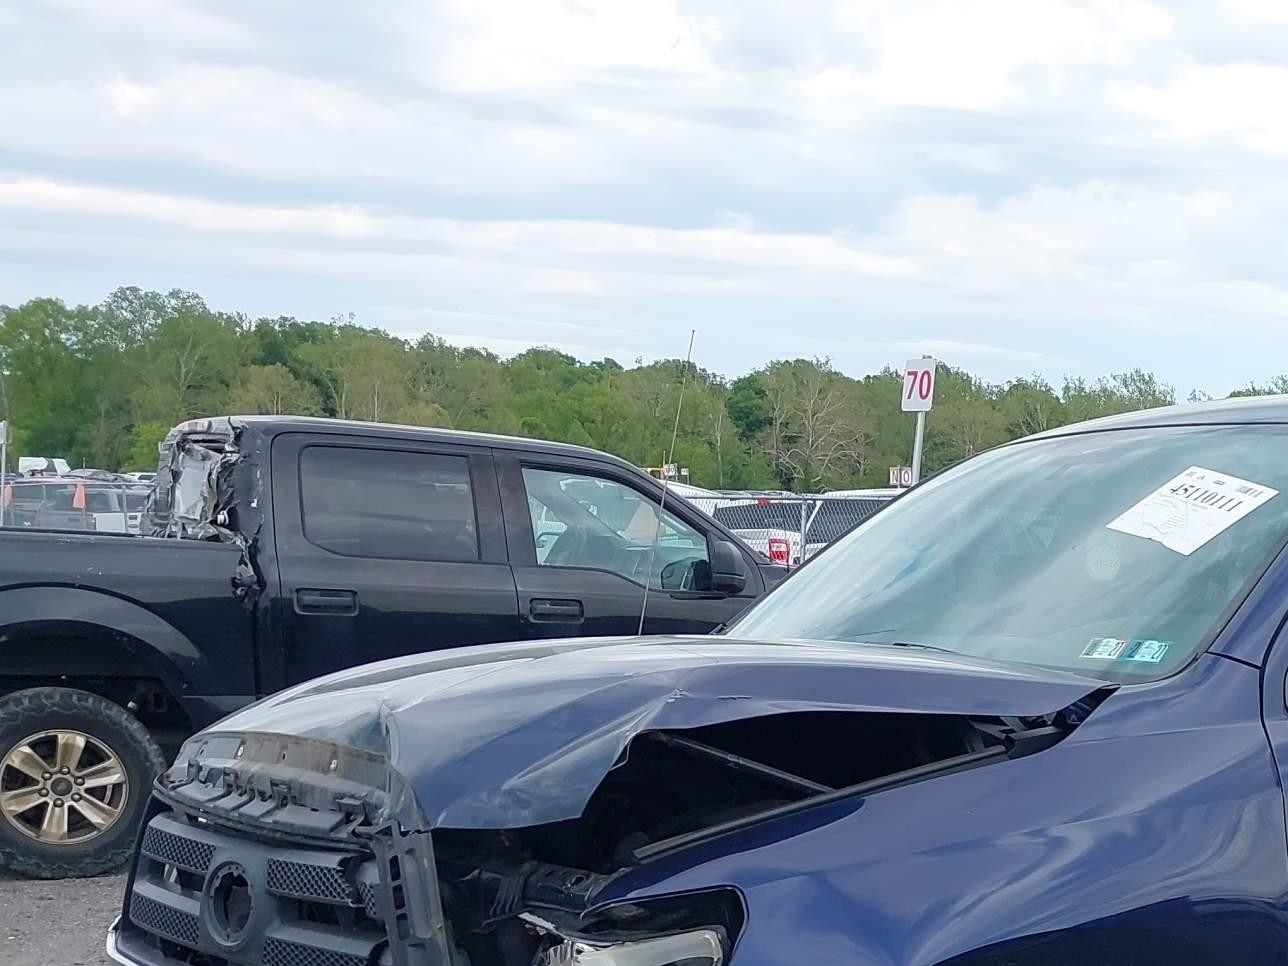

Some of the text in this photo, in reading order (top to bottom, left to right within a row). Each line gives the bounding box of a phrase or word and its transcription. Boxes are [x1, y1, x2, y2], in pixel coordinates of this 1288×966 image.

[906, 369, 932, 400] 70
[891, 469, 899, 482] N
[1170, 483, 1243, 512] 45110111
